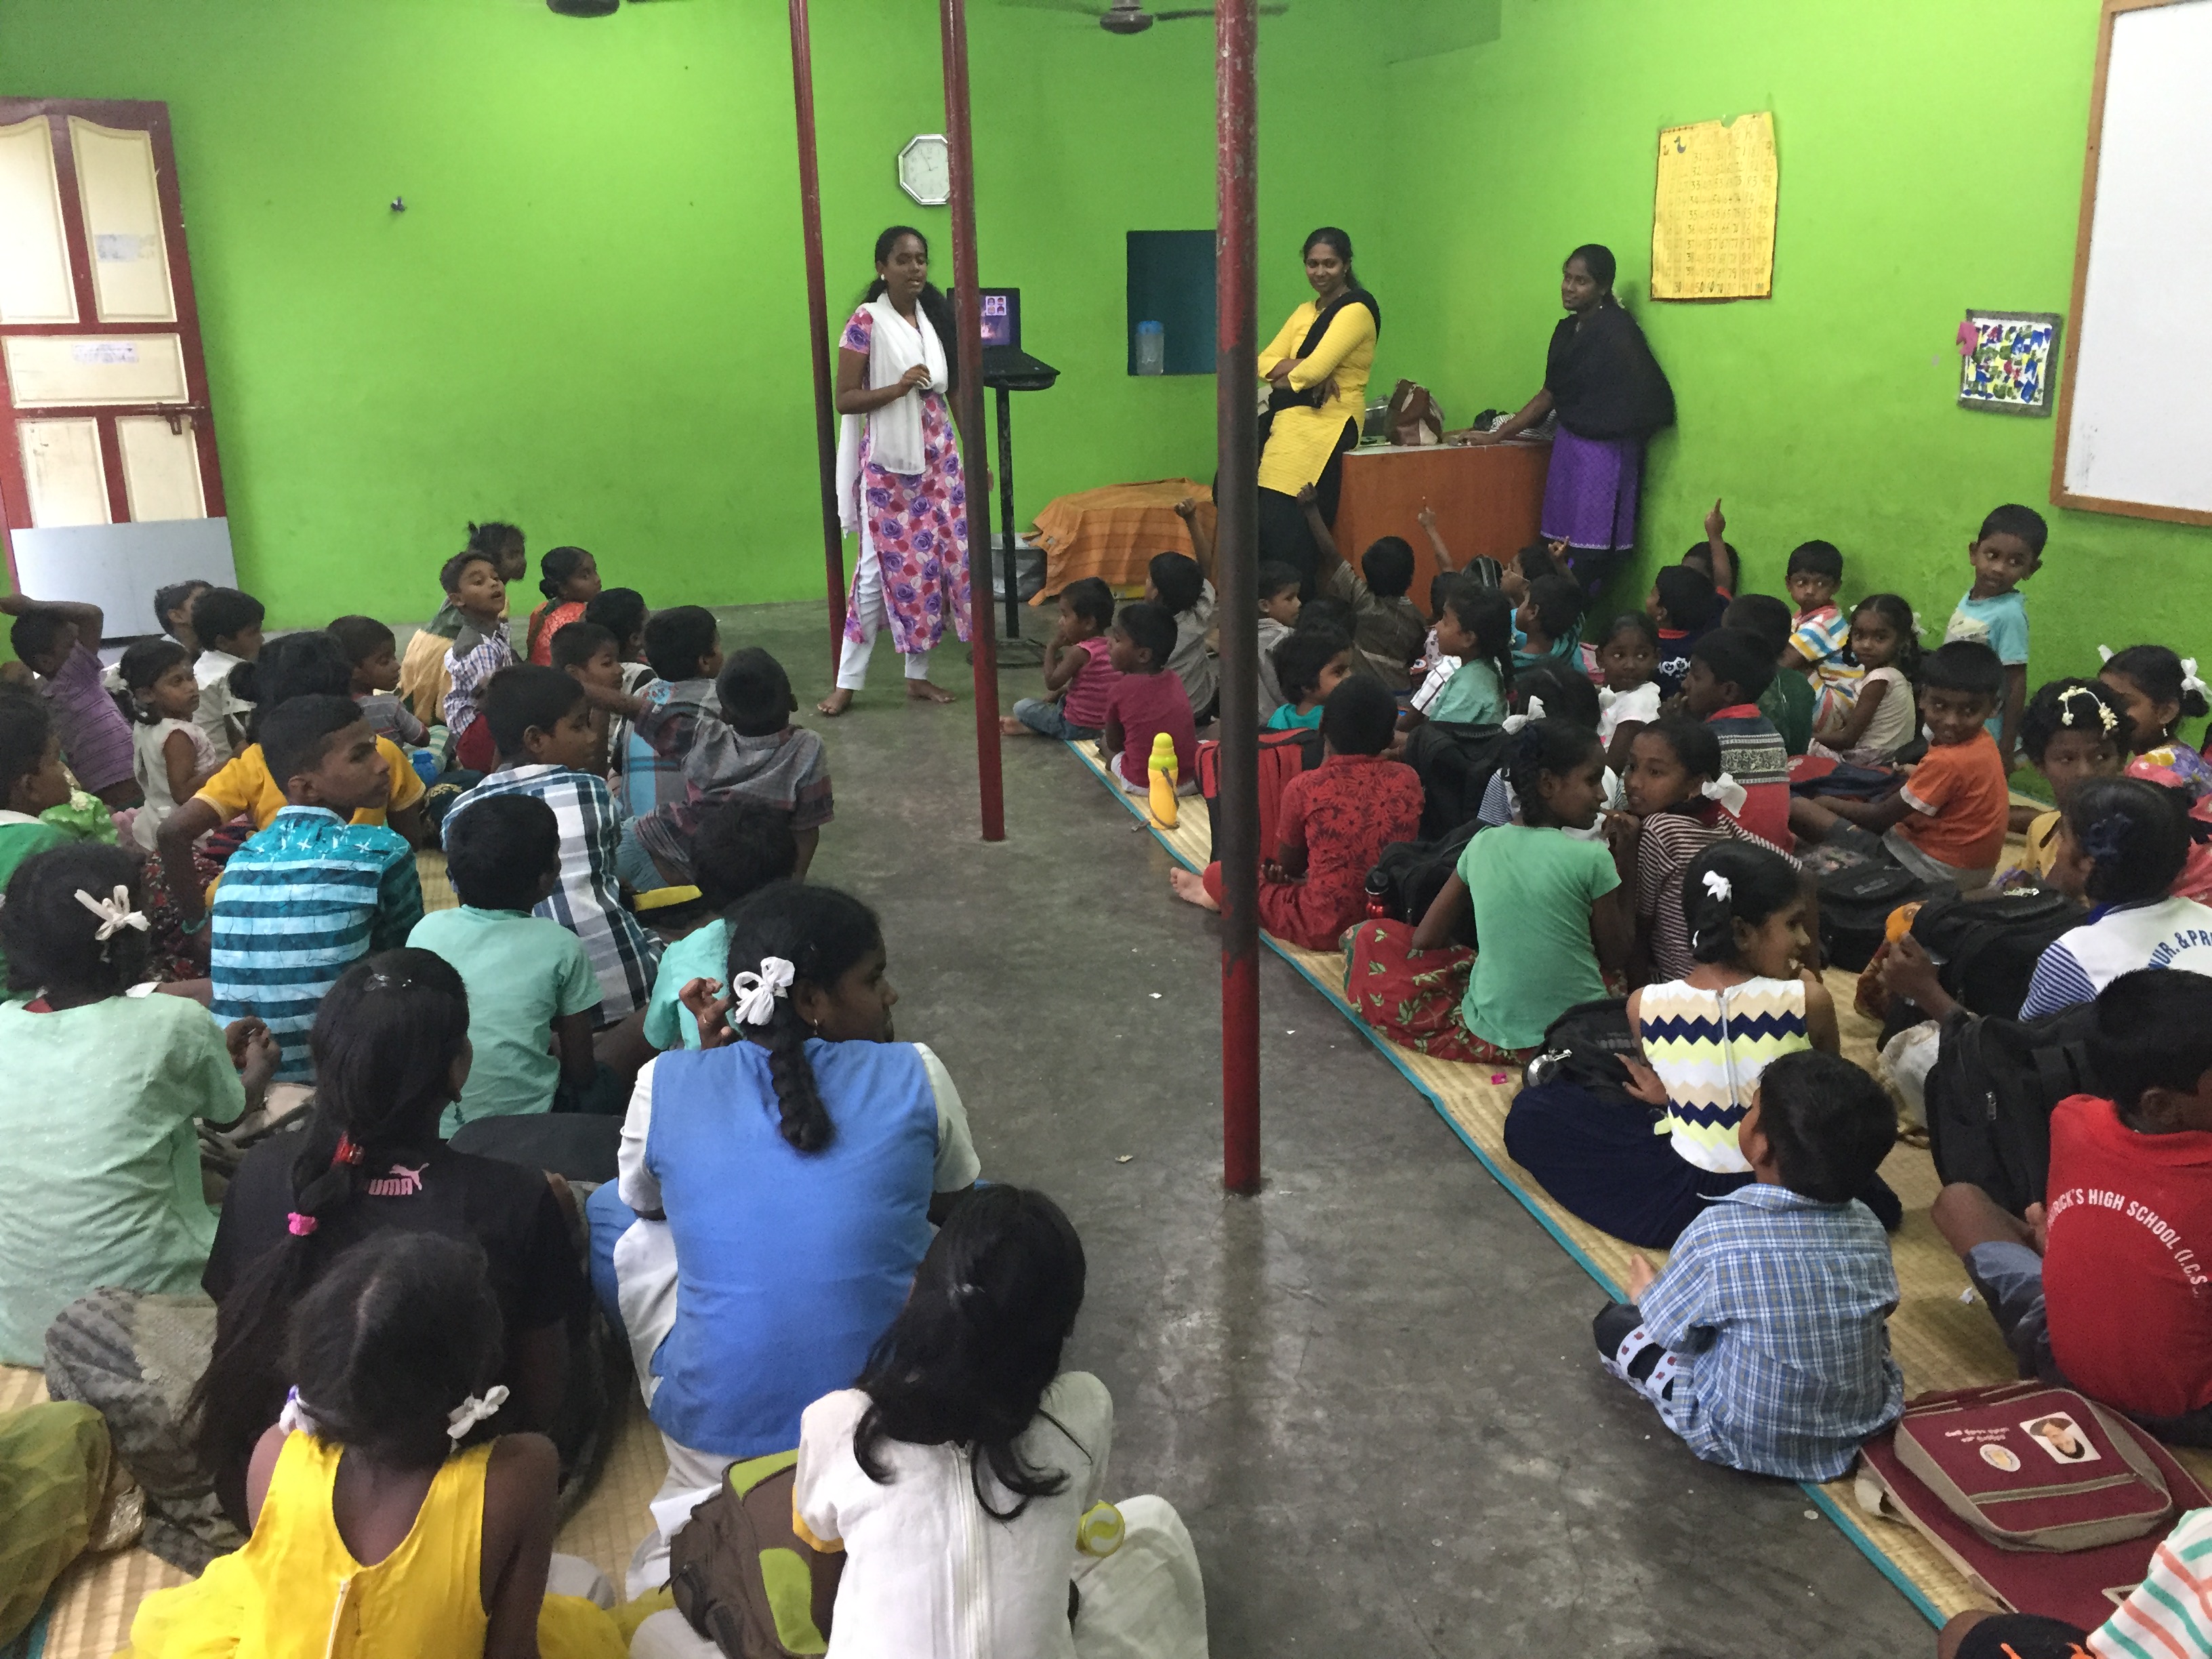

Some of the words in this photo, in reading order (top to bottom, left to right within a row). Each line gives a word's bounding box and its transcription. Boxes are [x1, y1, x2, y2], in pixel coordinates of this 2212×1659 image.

[1691, 180, 1700, 190] 33
[2174, 932, 2190, 949] &
[2186, 930, 2212, 946] PR
[368, 1177, 413, 1195] UMA
[2088, 1188, 2126, 1211] HIGH
[2126, 1200, 2182, 1250] SCHOOL
